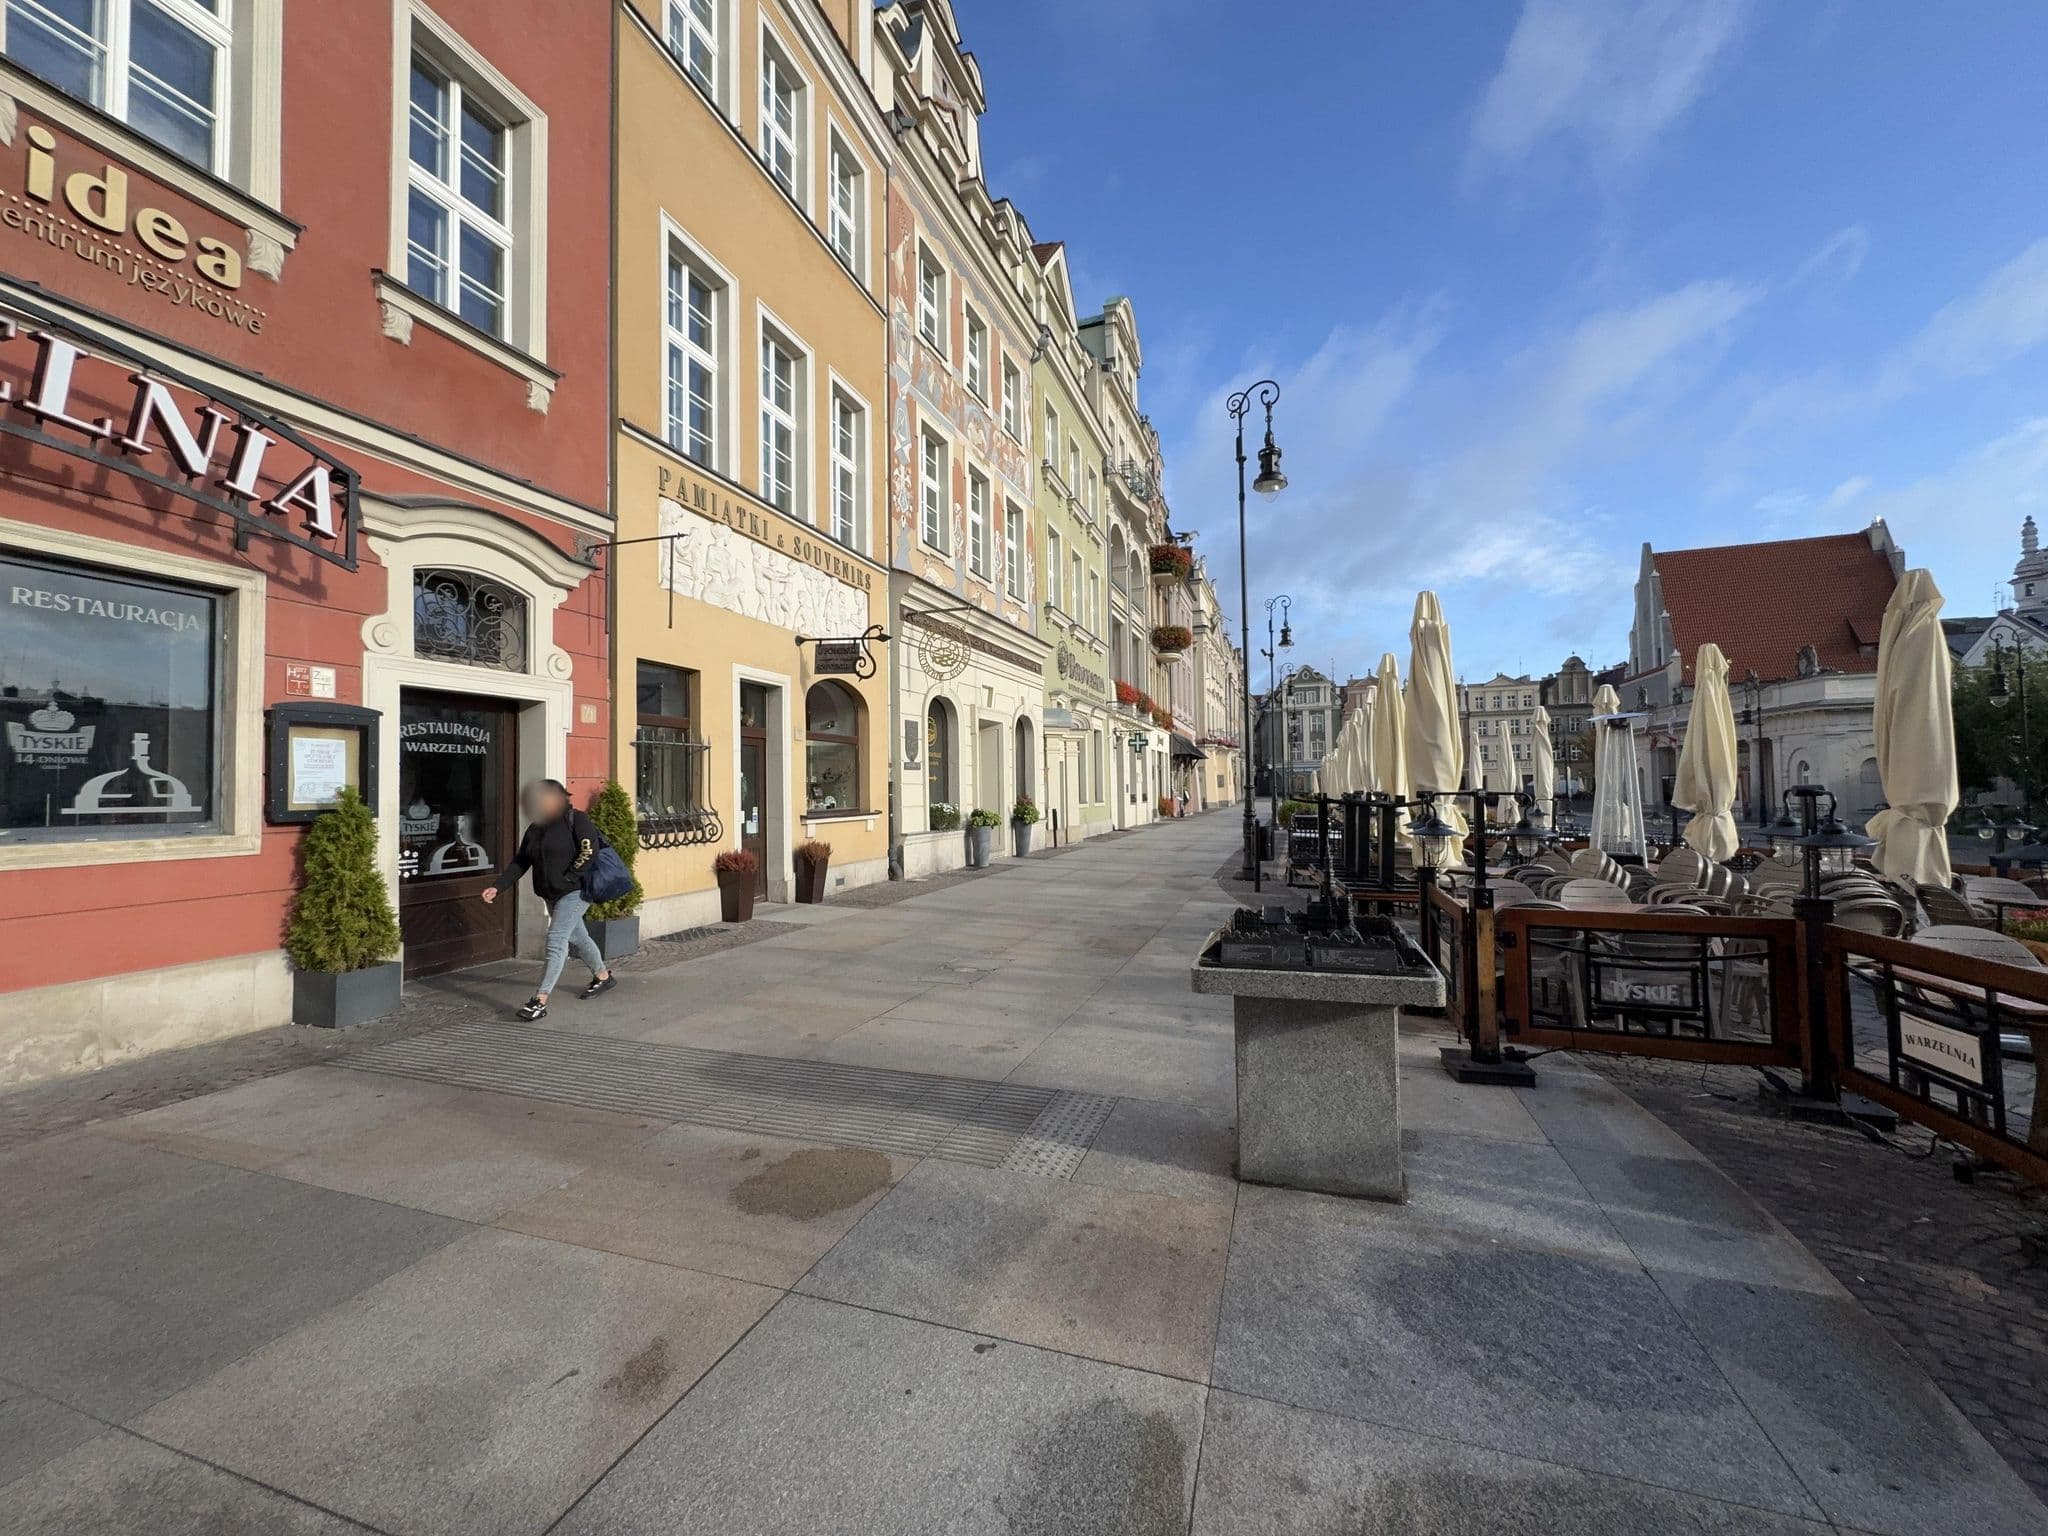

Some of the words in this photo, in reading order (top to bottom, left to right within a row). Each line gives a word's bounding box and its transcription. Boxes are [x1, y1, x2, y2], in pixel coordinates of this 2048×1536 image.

[27, 125, 242, 288] idea
[127, 257, 262, 334] językowe
[776, 533, 785, 549] &
[793, 535, 872, 590] SOUVENIRS
[11, 586, 201, 632] RESTAURACJA
[19, 734, 86, 750] TYSKIE
[399, 721, 490, 743] RESTAURACJA
[15, 753, 34, 765] 14
[405, 741, 487, 755] WARZELNIA
[403, 821, 437, 832] TYSKIE
[1609, 980, 1680, 1002] TYSKIE
[1904, 1033, 1976, 1069] WARZELNIA
